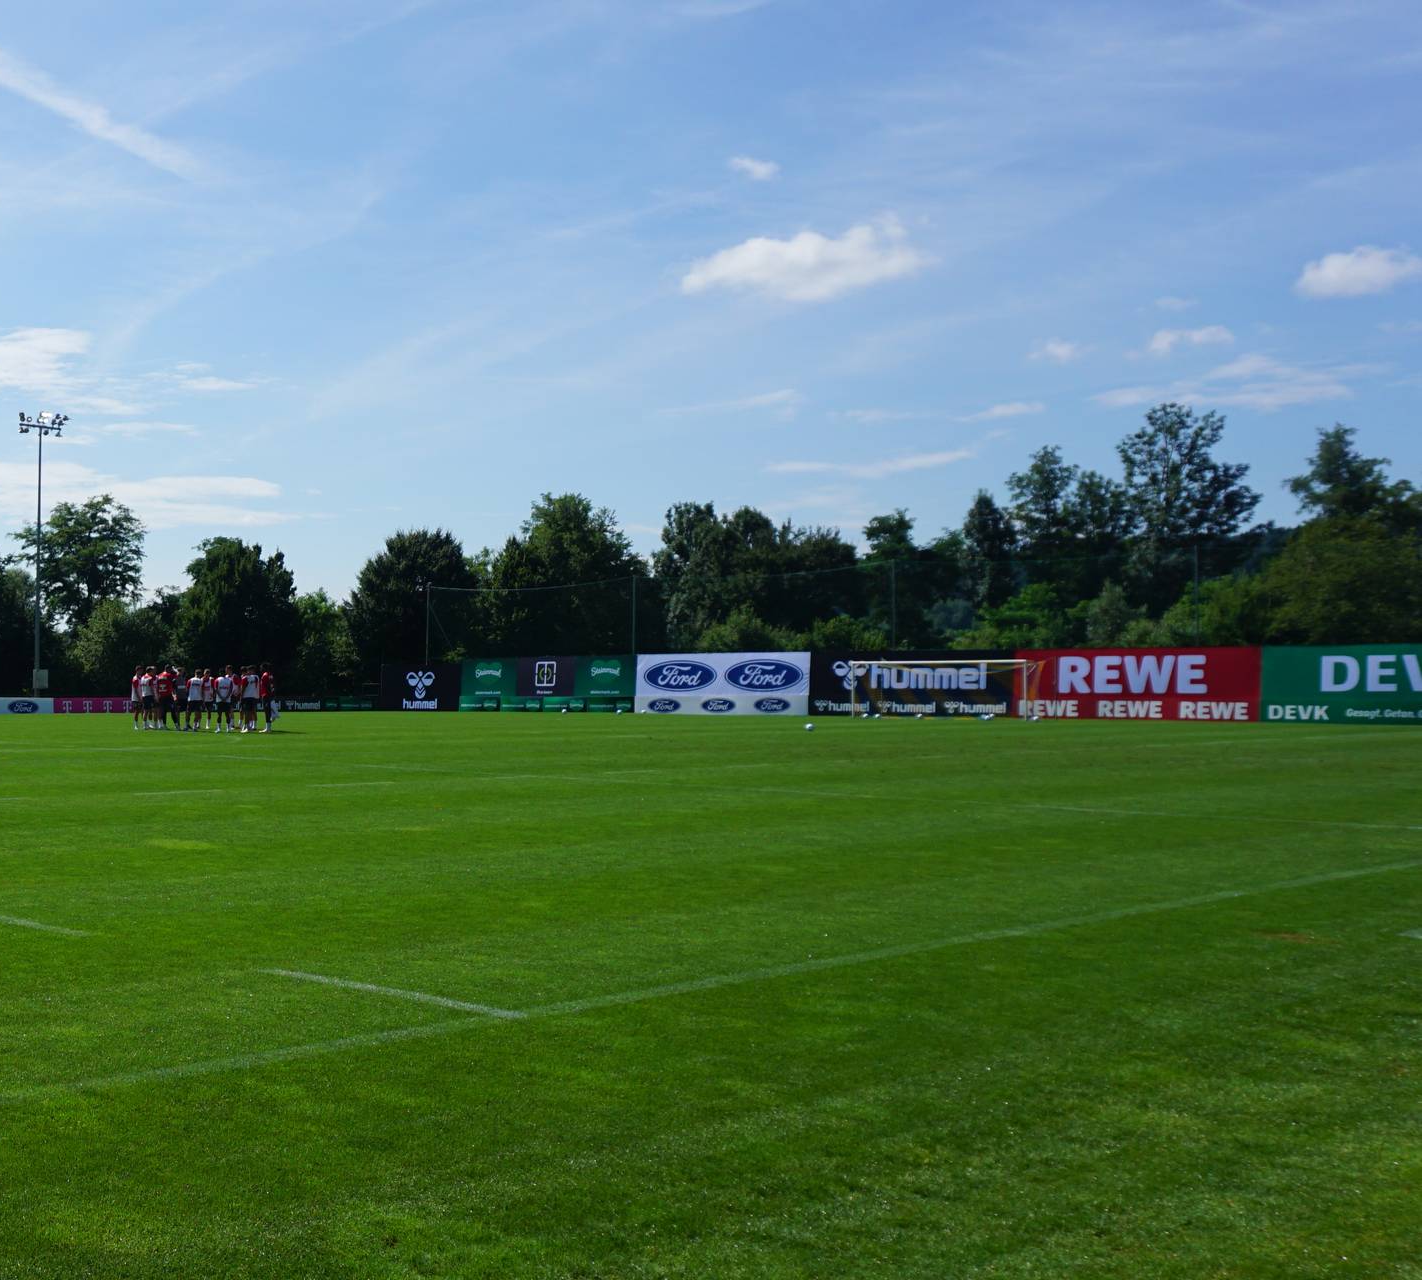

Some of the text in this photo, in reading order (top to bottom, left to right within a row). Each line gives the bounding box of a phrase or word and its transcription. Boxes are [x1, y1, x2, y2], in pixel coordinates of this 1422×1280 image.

[657, 664, 703, 686] Ford
[739, 663, 787, 686] Ford
[870, 662, 987, 690] hummel
[1058, 654, 1208, 694] REWE
[294, 700, 321, 710] hummel
[403, 698, 437, 710] hummel
[654, 700, 675, 711] Ford
[706, 700, 729, 711] Ford
[759, 700, 780, 711] Ford
[828, 700, 870, 712] hummel
[891, 701, 936, 713] hummel
[958, 701, 1006, 714] hummel
[1018, 699, 1079, 717] REWE
[1097, 700, 1162, 718] REWE
[1179, 701, 1249, 720] REWE
[1268, 704, 1329, 720] DEVK
